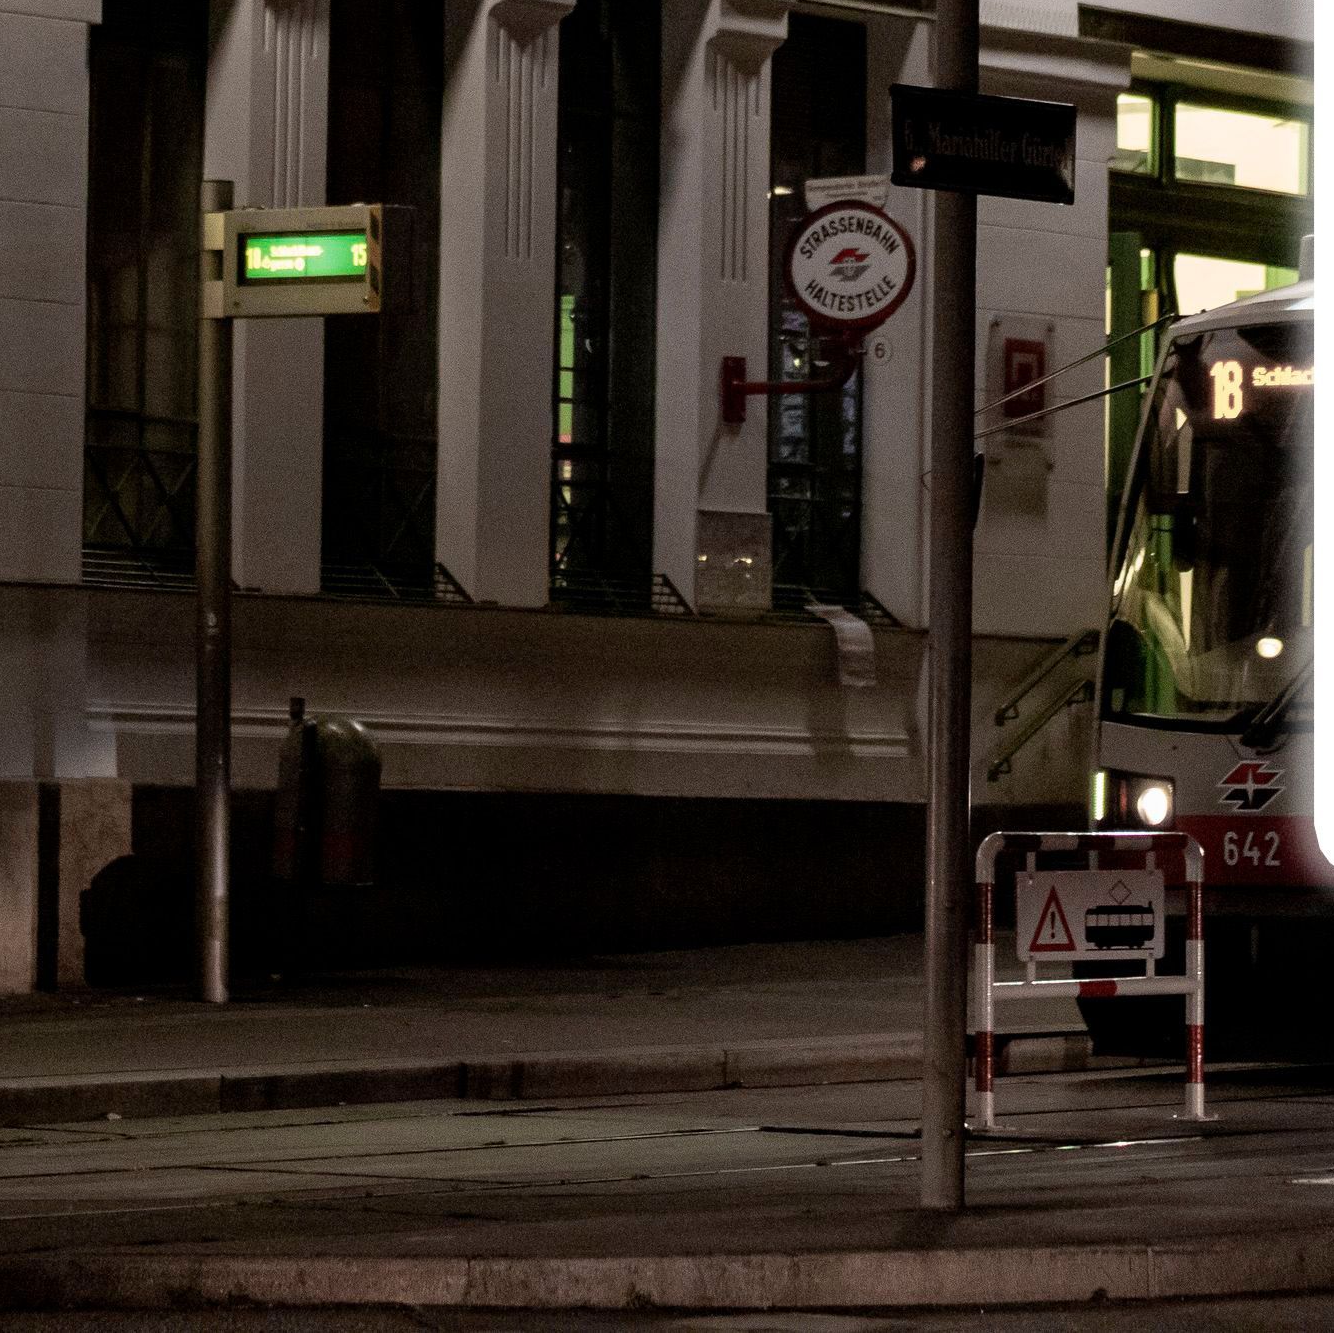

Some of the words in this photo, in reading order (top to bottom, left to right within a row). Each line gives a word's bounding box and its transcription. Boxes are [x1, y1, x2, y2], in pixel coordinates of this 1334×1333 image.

[799, 215, 900, 259] STRASSENBAHN
[805, 275, 897, 312] HALTESTELLE
[874, 342, 885, 358] 6
[1210, 360, 1243, 419] 18
[1223, 831, 1281, 867] 642
